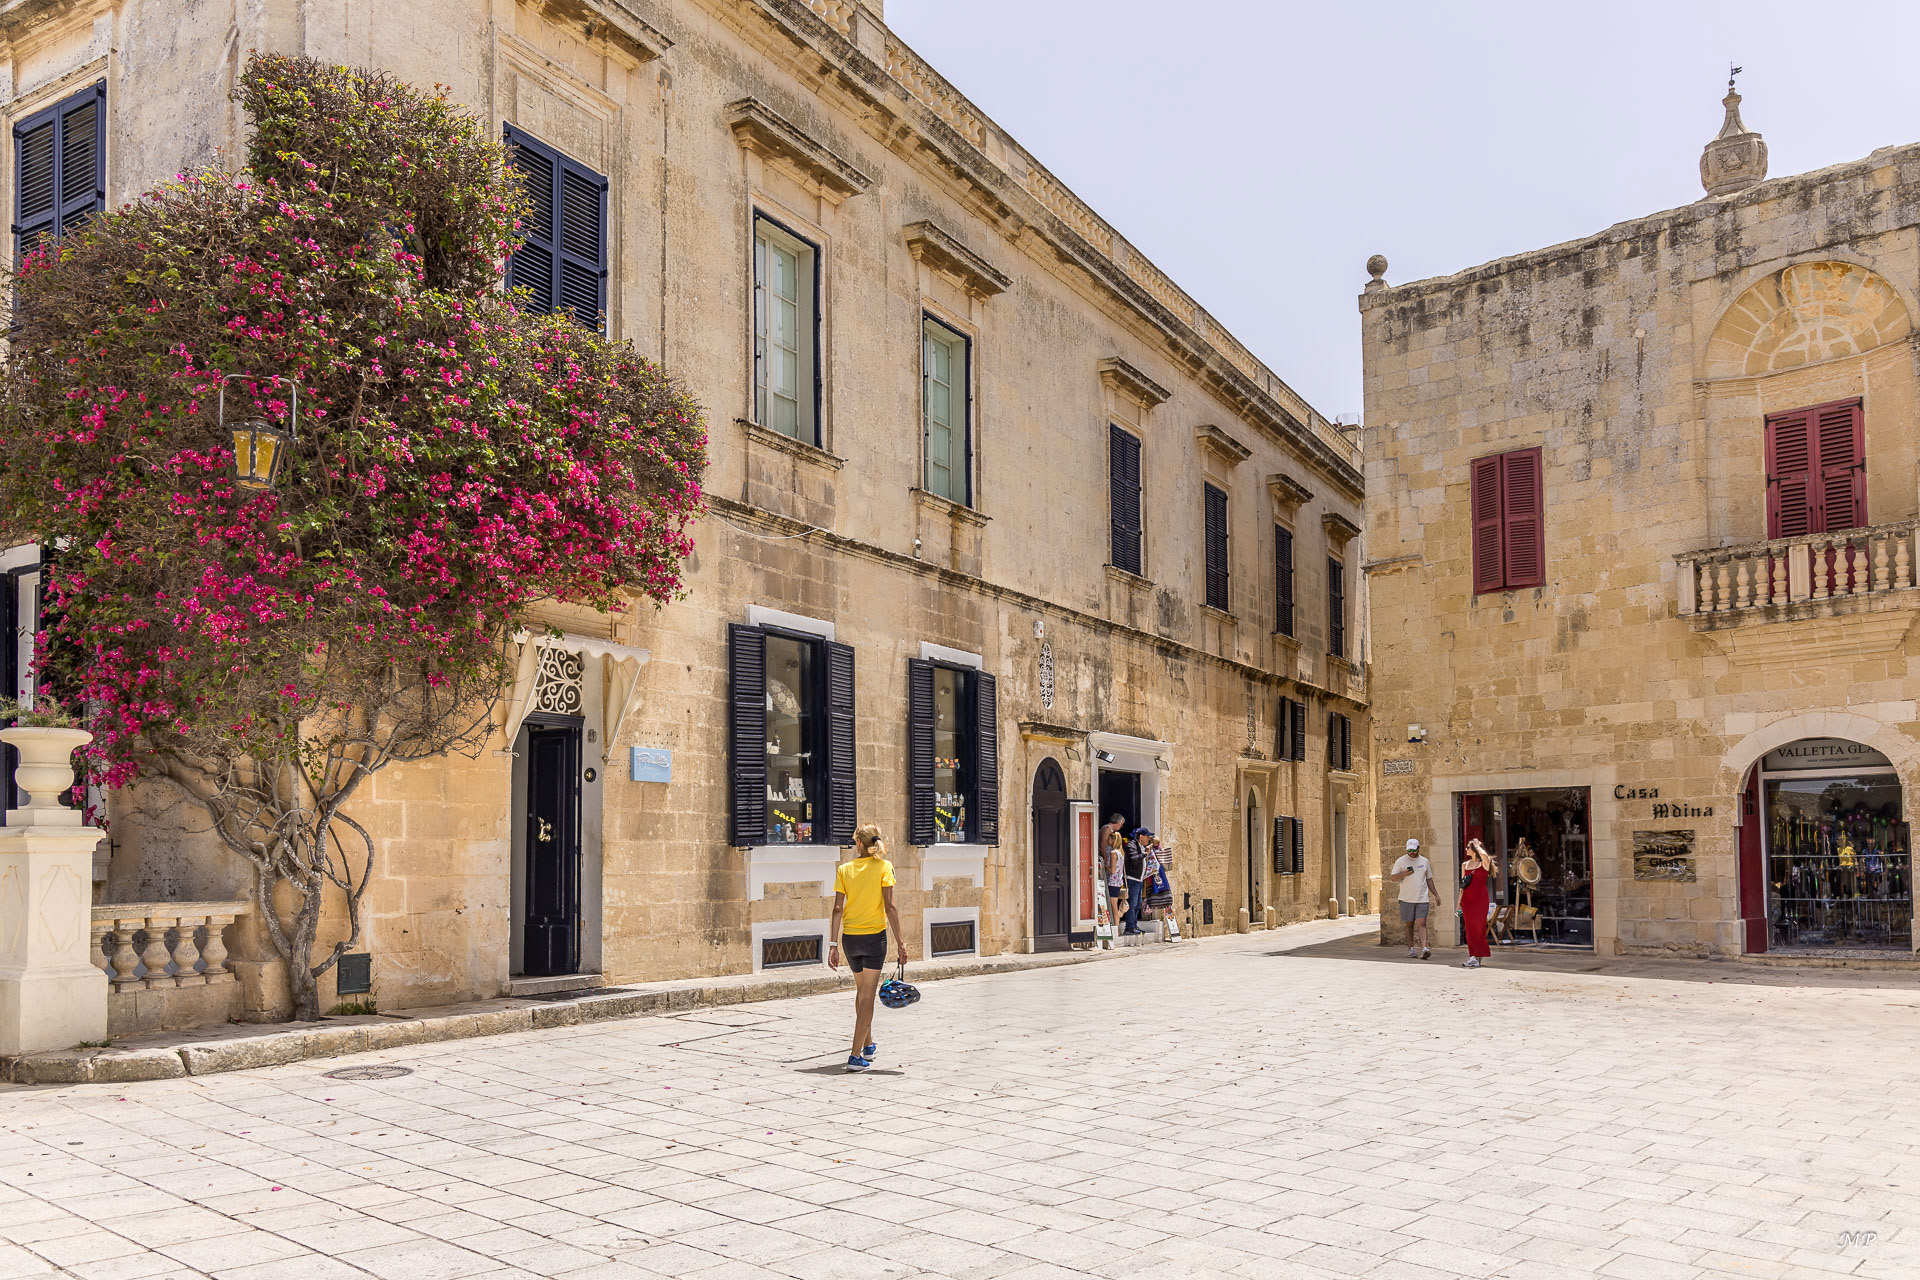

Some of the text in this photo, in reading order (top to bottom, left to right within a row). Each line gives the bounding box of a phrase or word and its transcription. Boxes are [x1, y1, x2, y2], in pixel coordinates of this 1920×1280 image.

[1778, 746, 1843, 757] VALLETTA
[1614, 784, 1659, 799] Casa
[773, 808, 796, 823] SALE
[1652, 803, 1713, 819] Mdina
[1649, 858, 1679, 867] Glass
